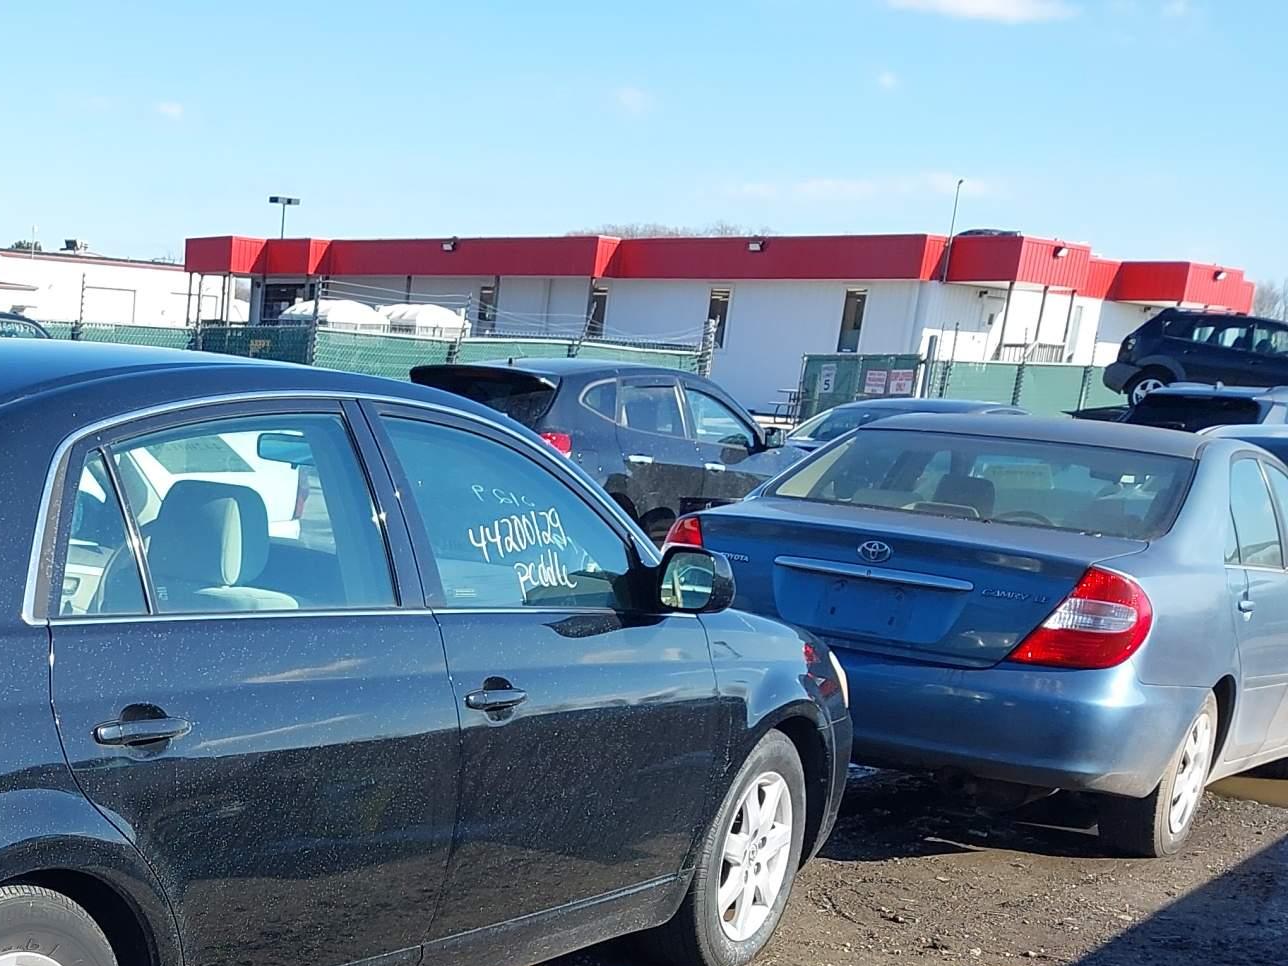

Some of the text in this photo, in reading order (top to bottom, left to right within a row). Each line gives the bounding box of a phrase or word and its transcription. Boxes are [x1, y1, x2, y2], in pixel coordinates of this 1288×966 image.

[824, 379, 830, 391] 5
[468, 507, 567, 563] 44200129
[981, 588, 1030, 601] CAMRY
